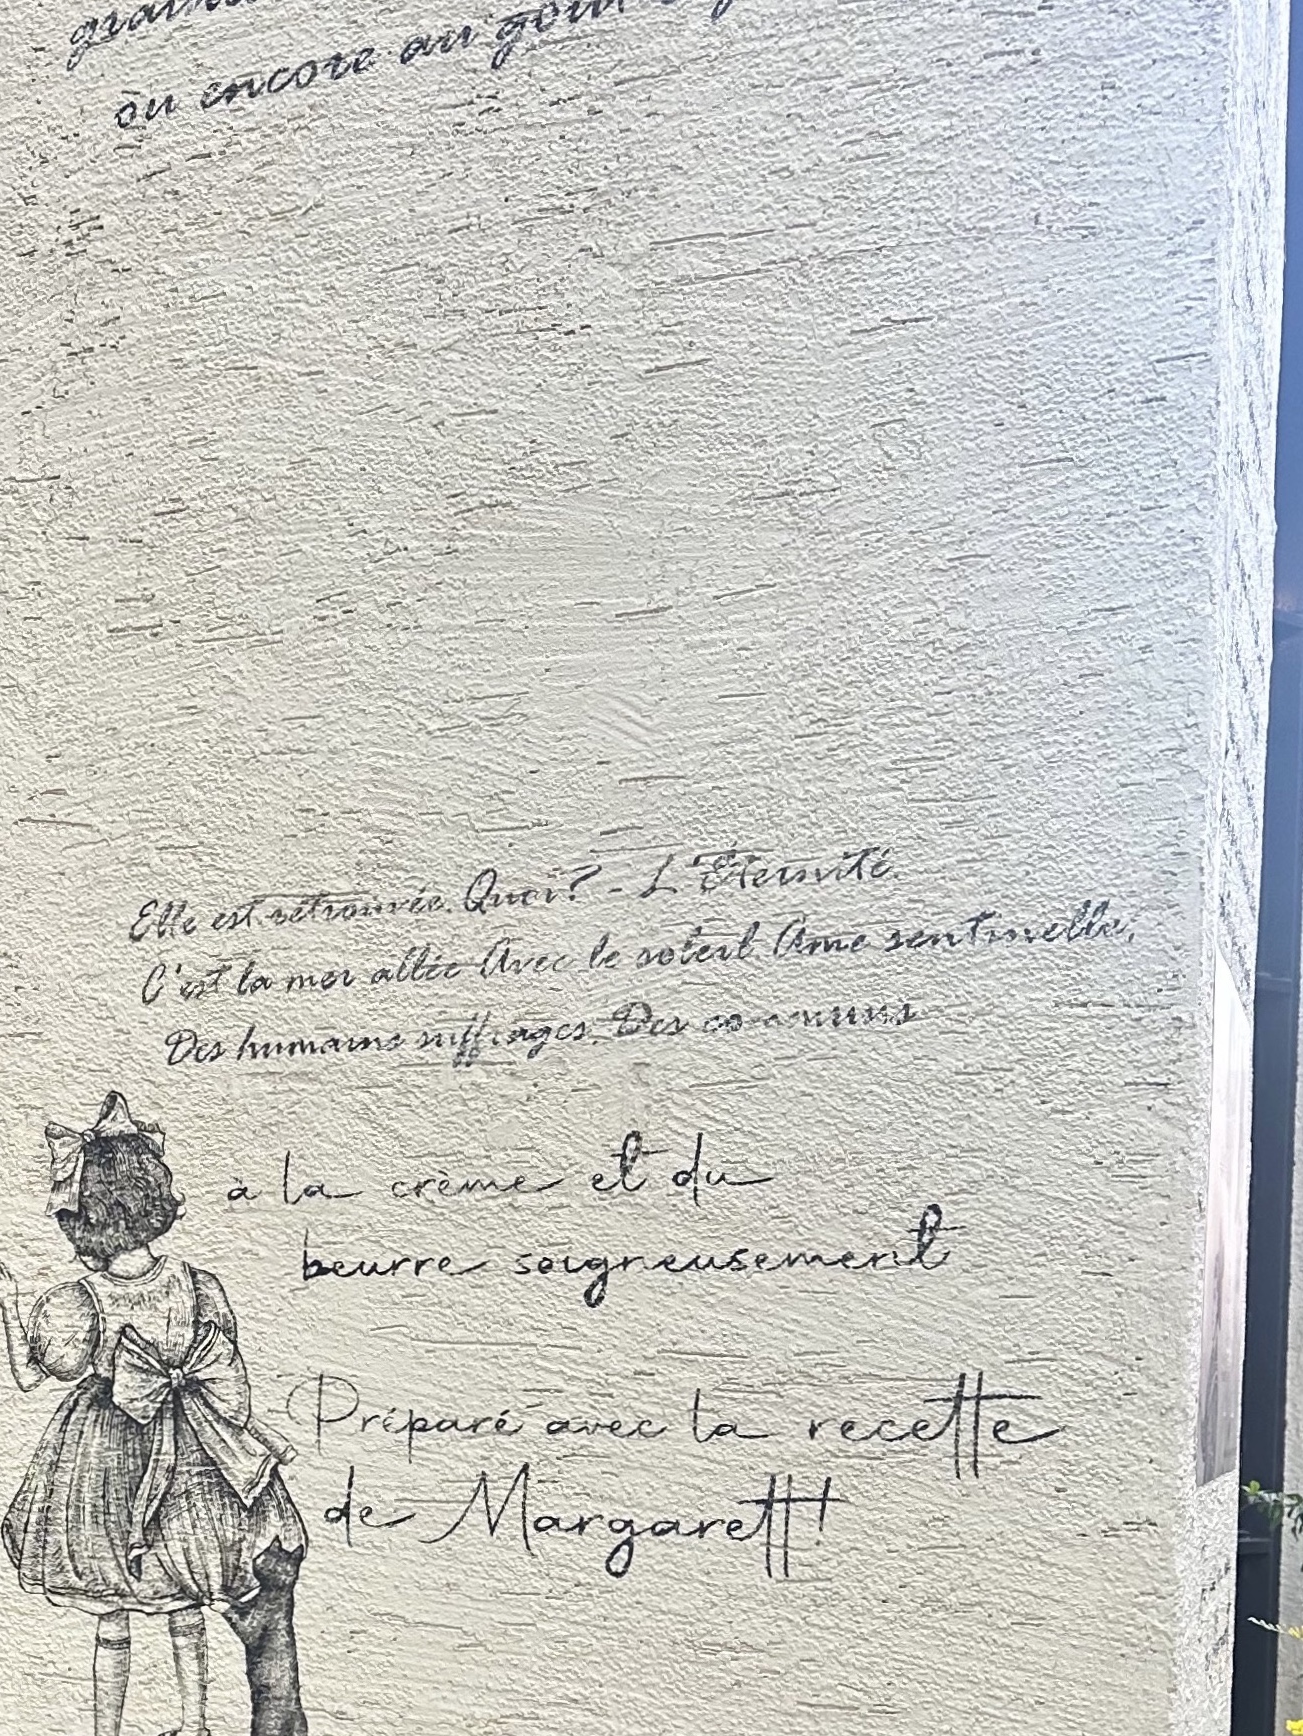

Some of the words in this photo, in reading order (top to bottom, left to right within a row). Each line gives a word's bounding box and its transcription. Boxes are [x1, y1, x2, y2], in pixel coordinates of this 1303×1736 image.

[199, 47, 376, 110] encore
[490, 0, 624, 70] gou
[128, 899, 197, 941] Elle
[141, 962, 225, 1006] C'est
[237, 961, 273, 996] la
[285, 966, 356, 992] mer
[588, 934, 618, 970] le
[164, 1028, 226, 1066] Des
[284, 1152, 364, 1205] la
[391, 1166, 564, 1198] crème
[591, 1131, 665, 1194] et
[672, 1133, 775, 1206] du
[302, 1229, 490, 1282] beurre
[515, 1204, 966, 1308] soigneusement
[286, 1373, 526, 1464] Préparé
[546, 1414, 670, 1440] avec
[692, 1388, 769, 1443] la
[808, 1372, 1062, 1480] recette
[323, 1466, 416, 1547] de
